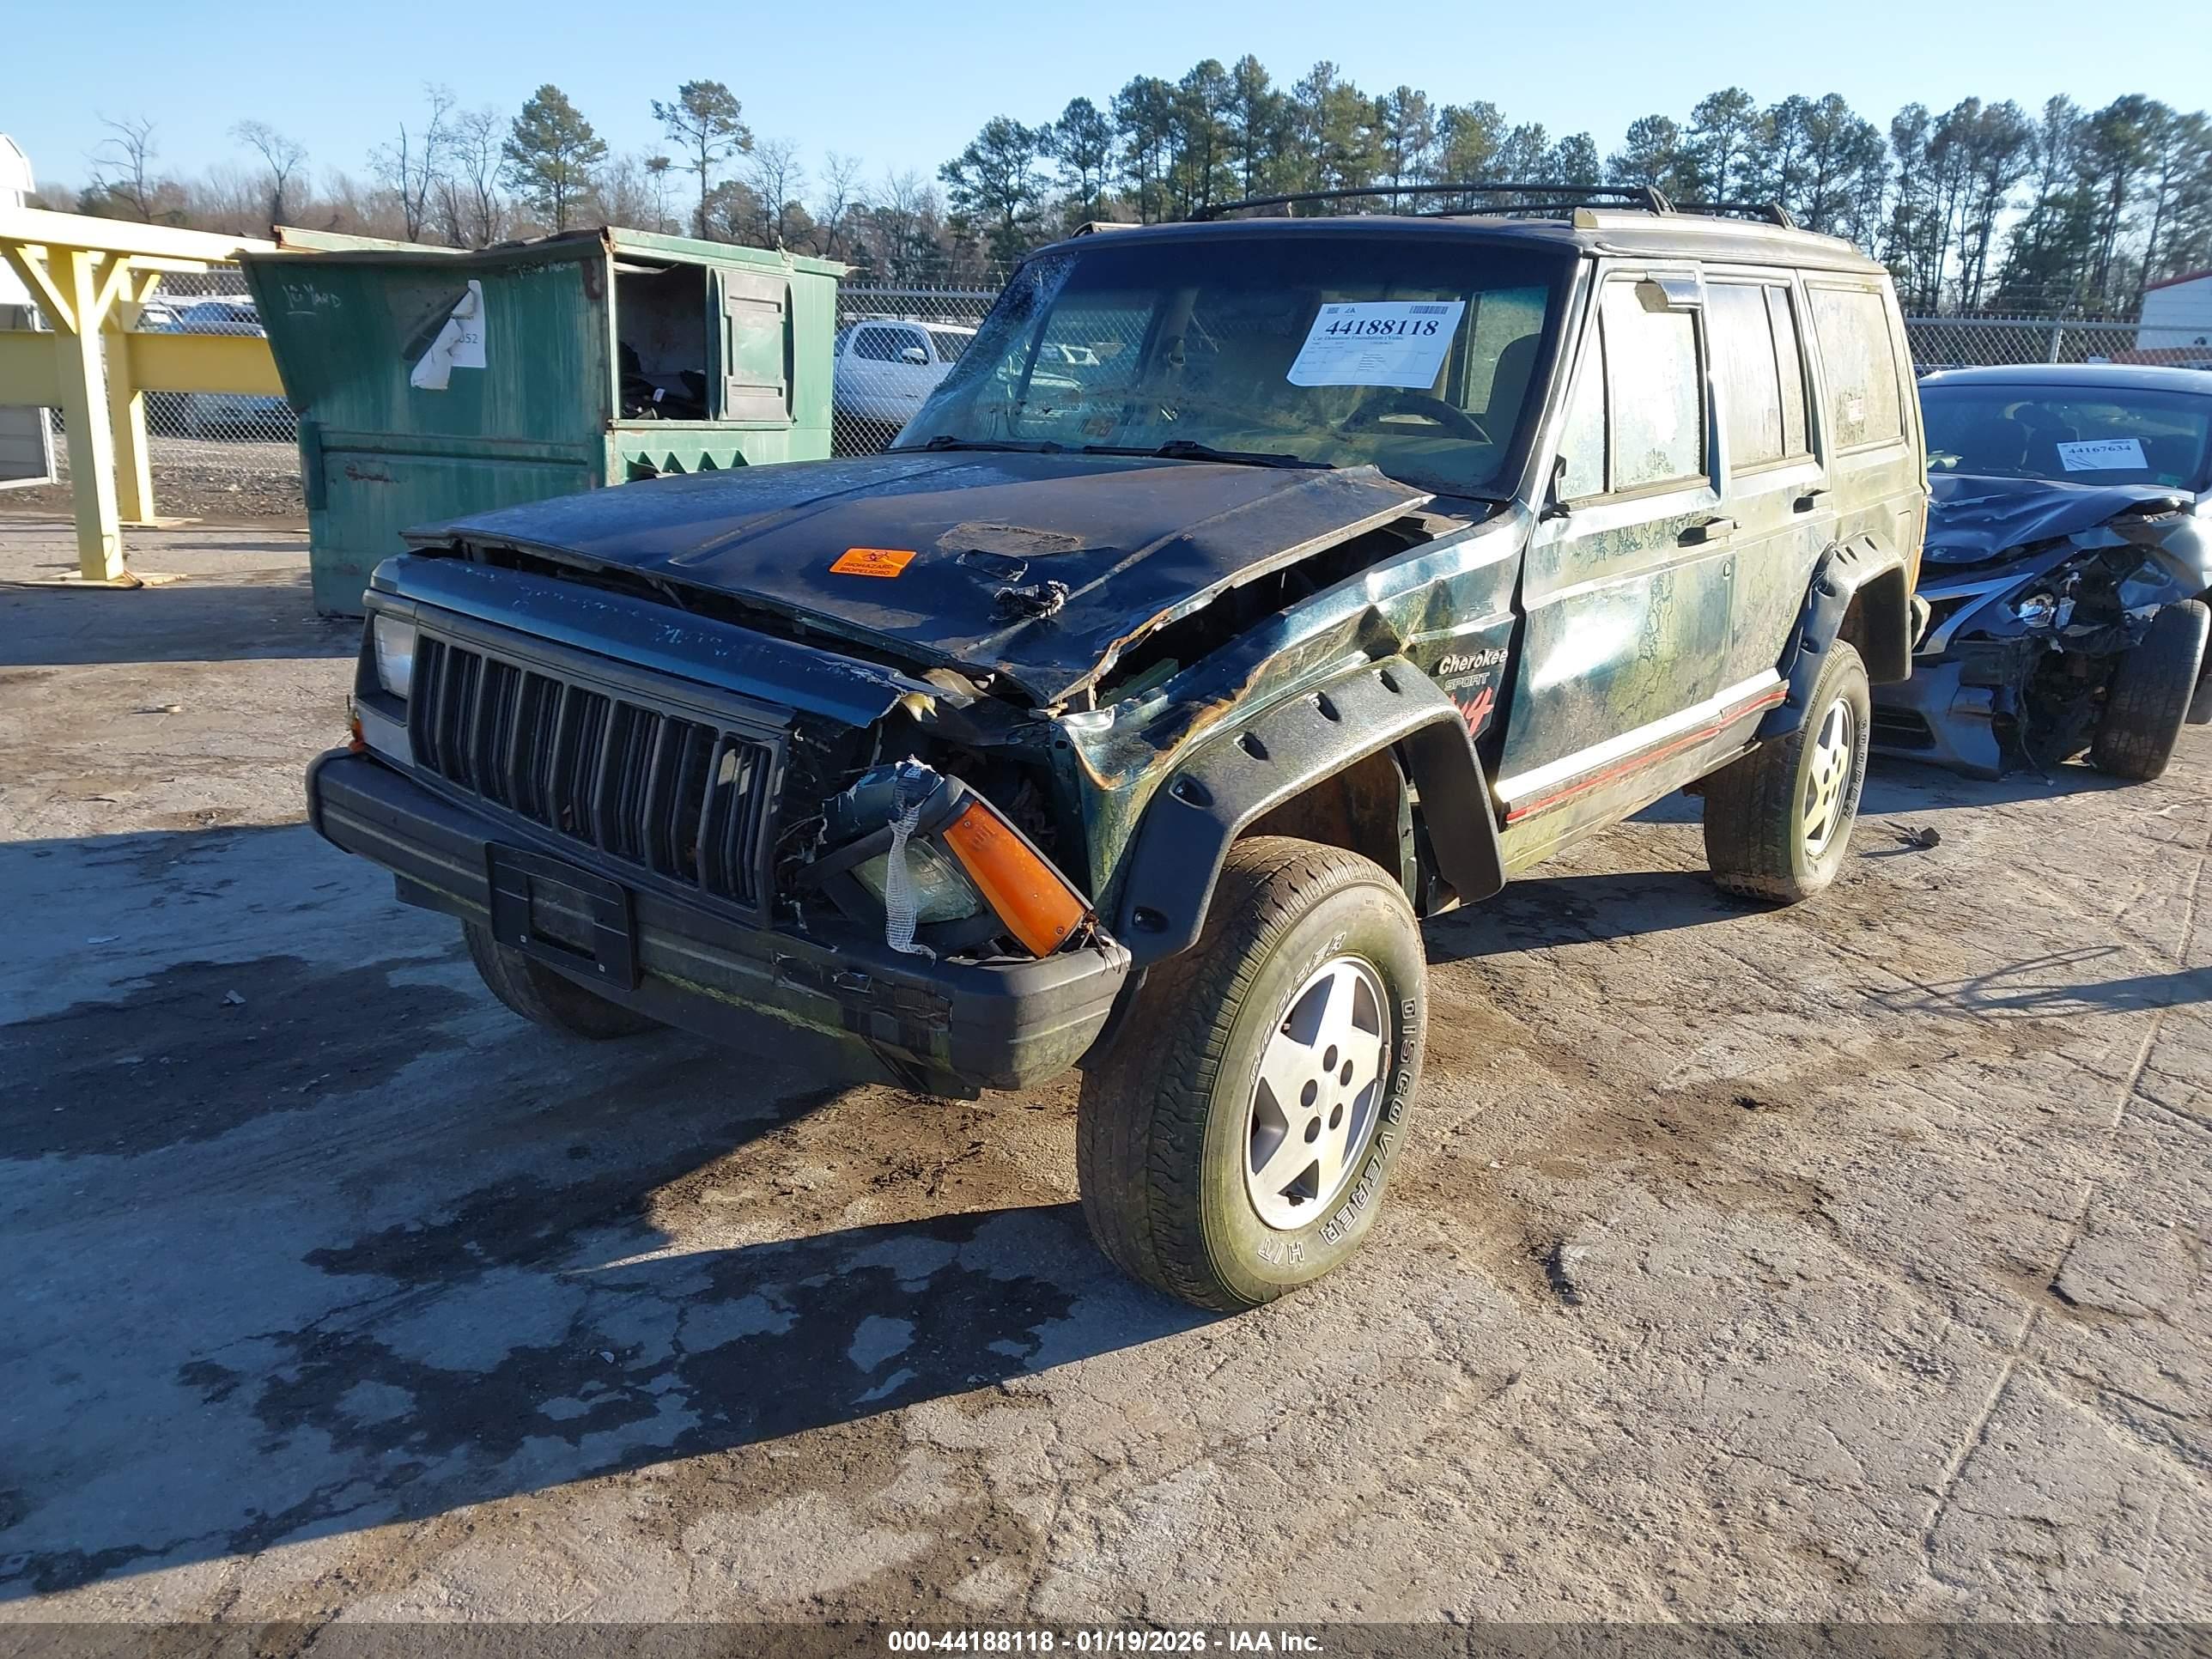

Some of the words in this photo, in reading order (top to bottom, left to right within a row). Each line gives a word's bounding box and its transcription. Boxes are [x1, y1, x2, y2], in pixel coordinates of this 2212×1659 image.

[1325, 319, 1439, 336] 44188118
[2068, 445, 2131, 454] 44167634
[839, 567, 890, 575] BIOPELIGRO
[1438, 648, 1509, 675] Cherokee
[1443, 672, 1491, 691] SPORT
[1319, 998, 1417, 1245] DISCOVERER
[1257, 1237, 1305, 1264] H/T
